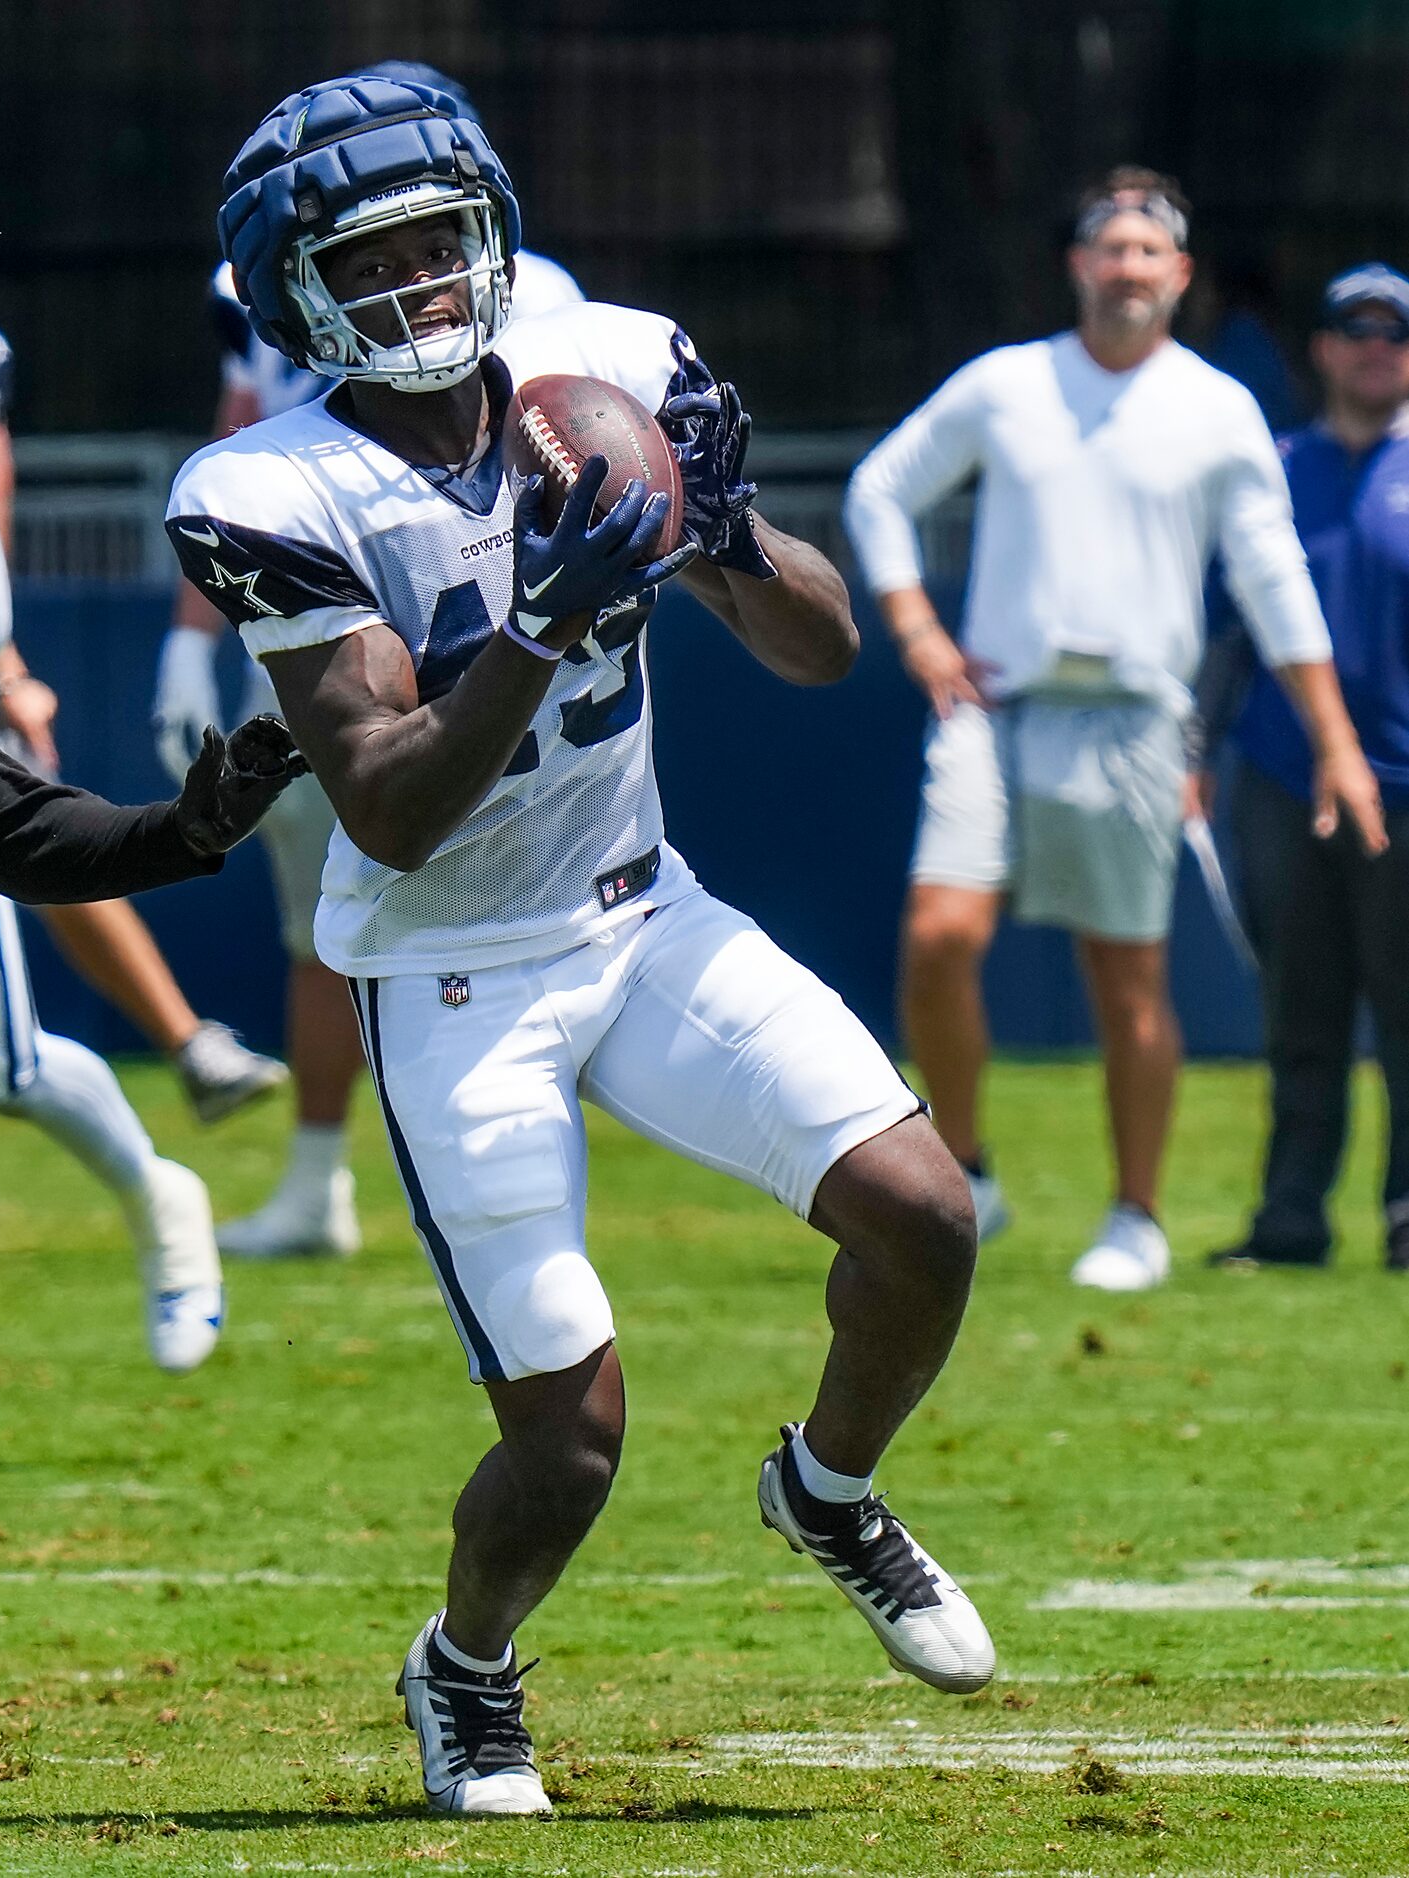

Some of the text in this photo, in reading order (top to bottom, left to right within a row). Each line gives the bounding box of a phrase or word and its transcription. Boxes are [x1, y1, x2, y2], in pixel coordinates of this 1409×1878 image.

[627, 430, 653, 480] NATIONAL
[460, 528, 514, 560] COWBO
[444, 986, 467, 1003] NFL
